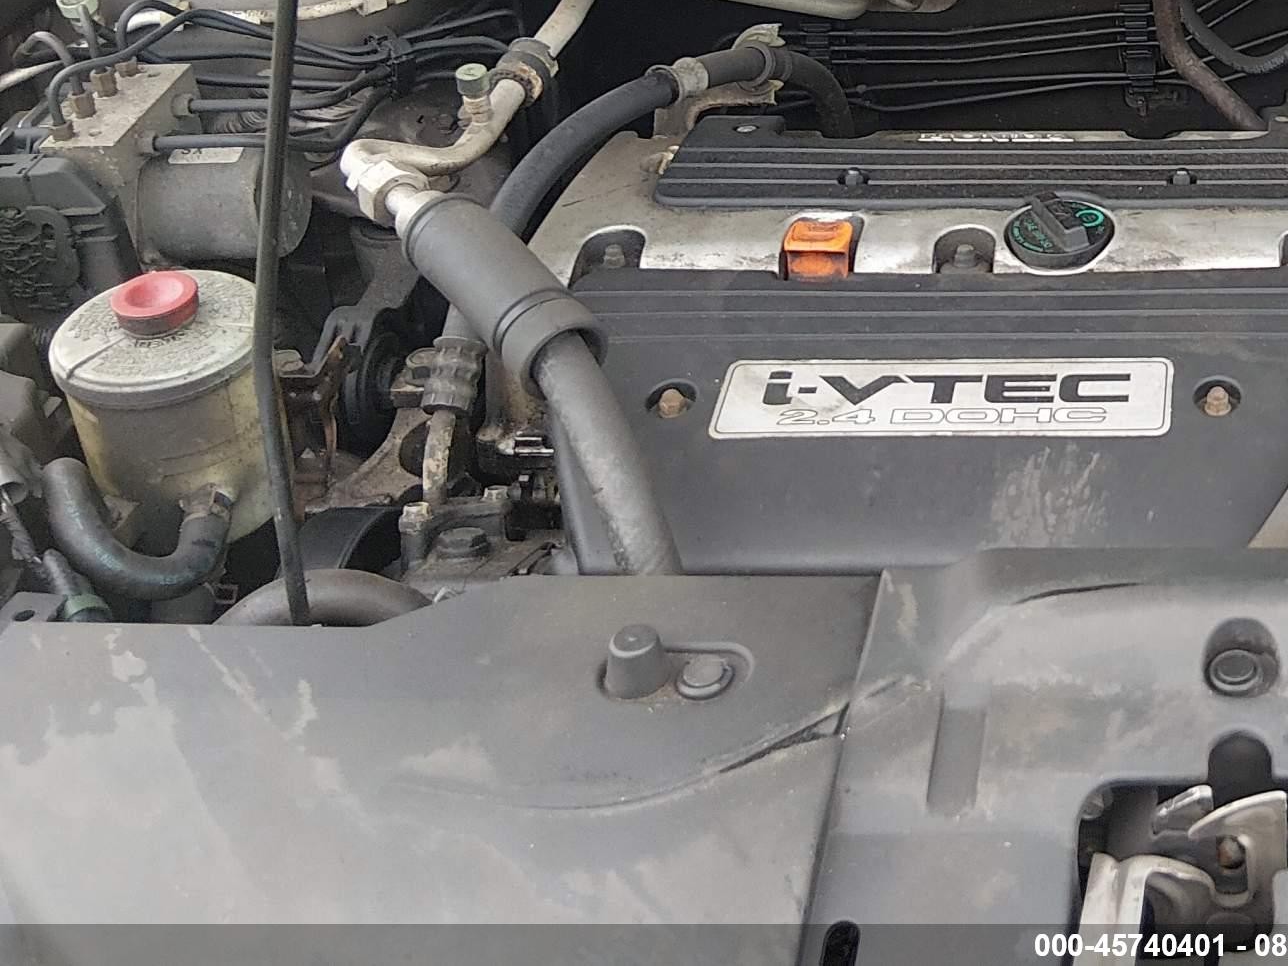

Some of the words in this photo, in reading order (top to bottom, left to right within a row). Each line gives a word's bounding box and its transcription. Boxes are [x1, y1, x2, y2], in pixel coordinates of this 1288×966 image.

[761, 370, 1132, 406] i-VTEC
[776, 408, 876, 426] 2.4
[890, 407, 1107, 425] DOHC
